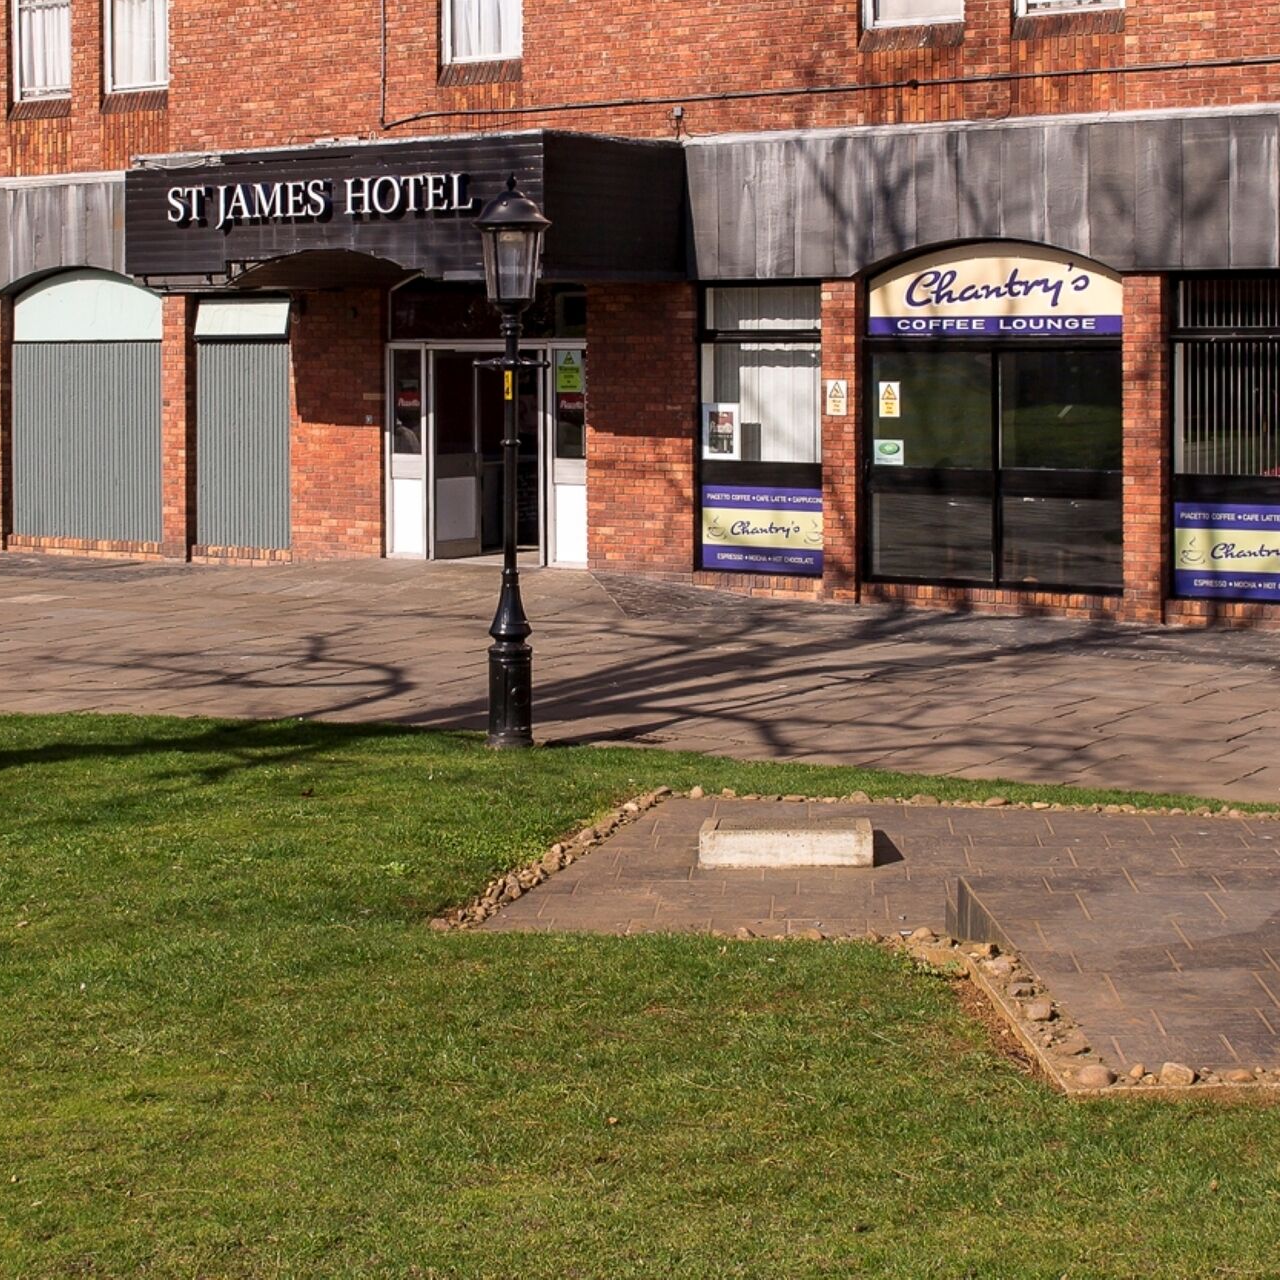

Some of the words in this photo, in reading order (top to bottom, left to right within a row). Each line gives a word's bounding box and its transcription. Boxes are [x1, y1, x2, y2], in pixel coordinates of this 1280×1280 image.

[167, 186, 205, 222] ST
[215, 179, 325, 230] JAMES
[344, 173, 474, 215] HOTEL
[905, 261, 1091, 308] Chantry's
[896, 319, 986, 331] COFFEE
[999, 317, 1097, 330] LOUNGE
[732, 494, 751, 502] COFFEE
[755, 495, 770, 503] CAFE
[1180, 511, 1210, 520] PIACETTO
[1211, 512, 1236, 521] COFFEE
[1242, 513, 1260, 522] CAFE
[1261, 514, 1280, 523] LATTE
[730, 520, 801, 539] Chantry's
[716, 552, 744, 561] ESPRESSO
[748, 554, 768, 563] MOCHA
[784, 556, 814, 565] CHOCOLATE
[1193, 578, 1227, 588] ESPRESSO
[1233, 580, 1257, 589] MOCHA
[1263, 581, 1277, 590] HOT
